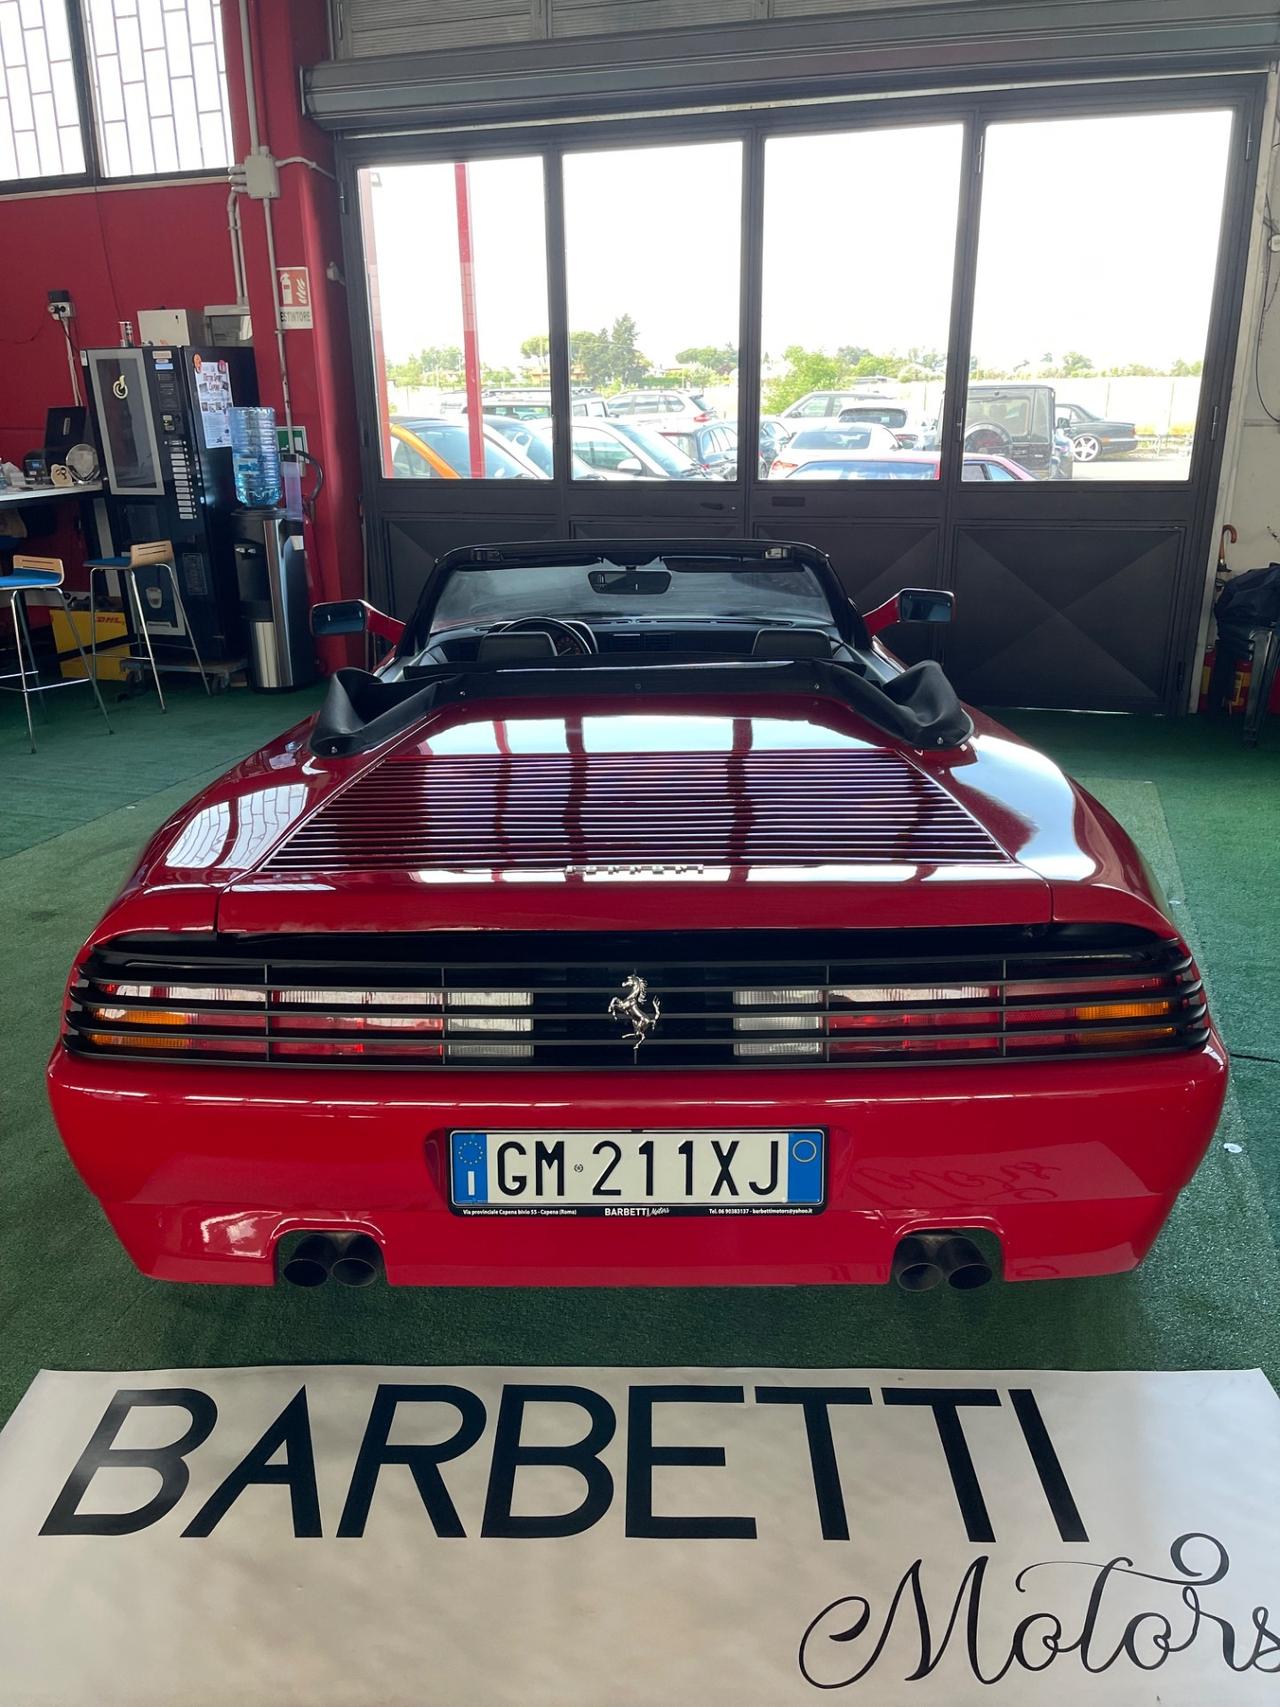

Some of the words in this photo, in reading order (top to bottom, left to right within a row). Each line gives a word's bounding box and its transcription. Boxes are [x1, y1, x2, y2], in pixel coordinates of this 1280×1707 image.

[96, 616, 121, 624] DHL
[496, 1141, 565, 1197] GM
[592, 1141, 779, 1197] 211XJ
[604, 1207, 650, 1217] BARBETTI
[38, 1384, 1090, 1544] BARBETTI
[799, 1532, 1280, 1689] Motors
